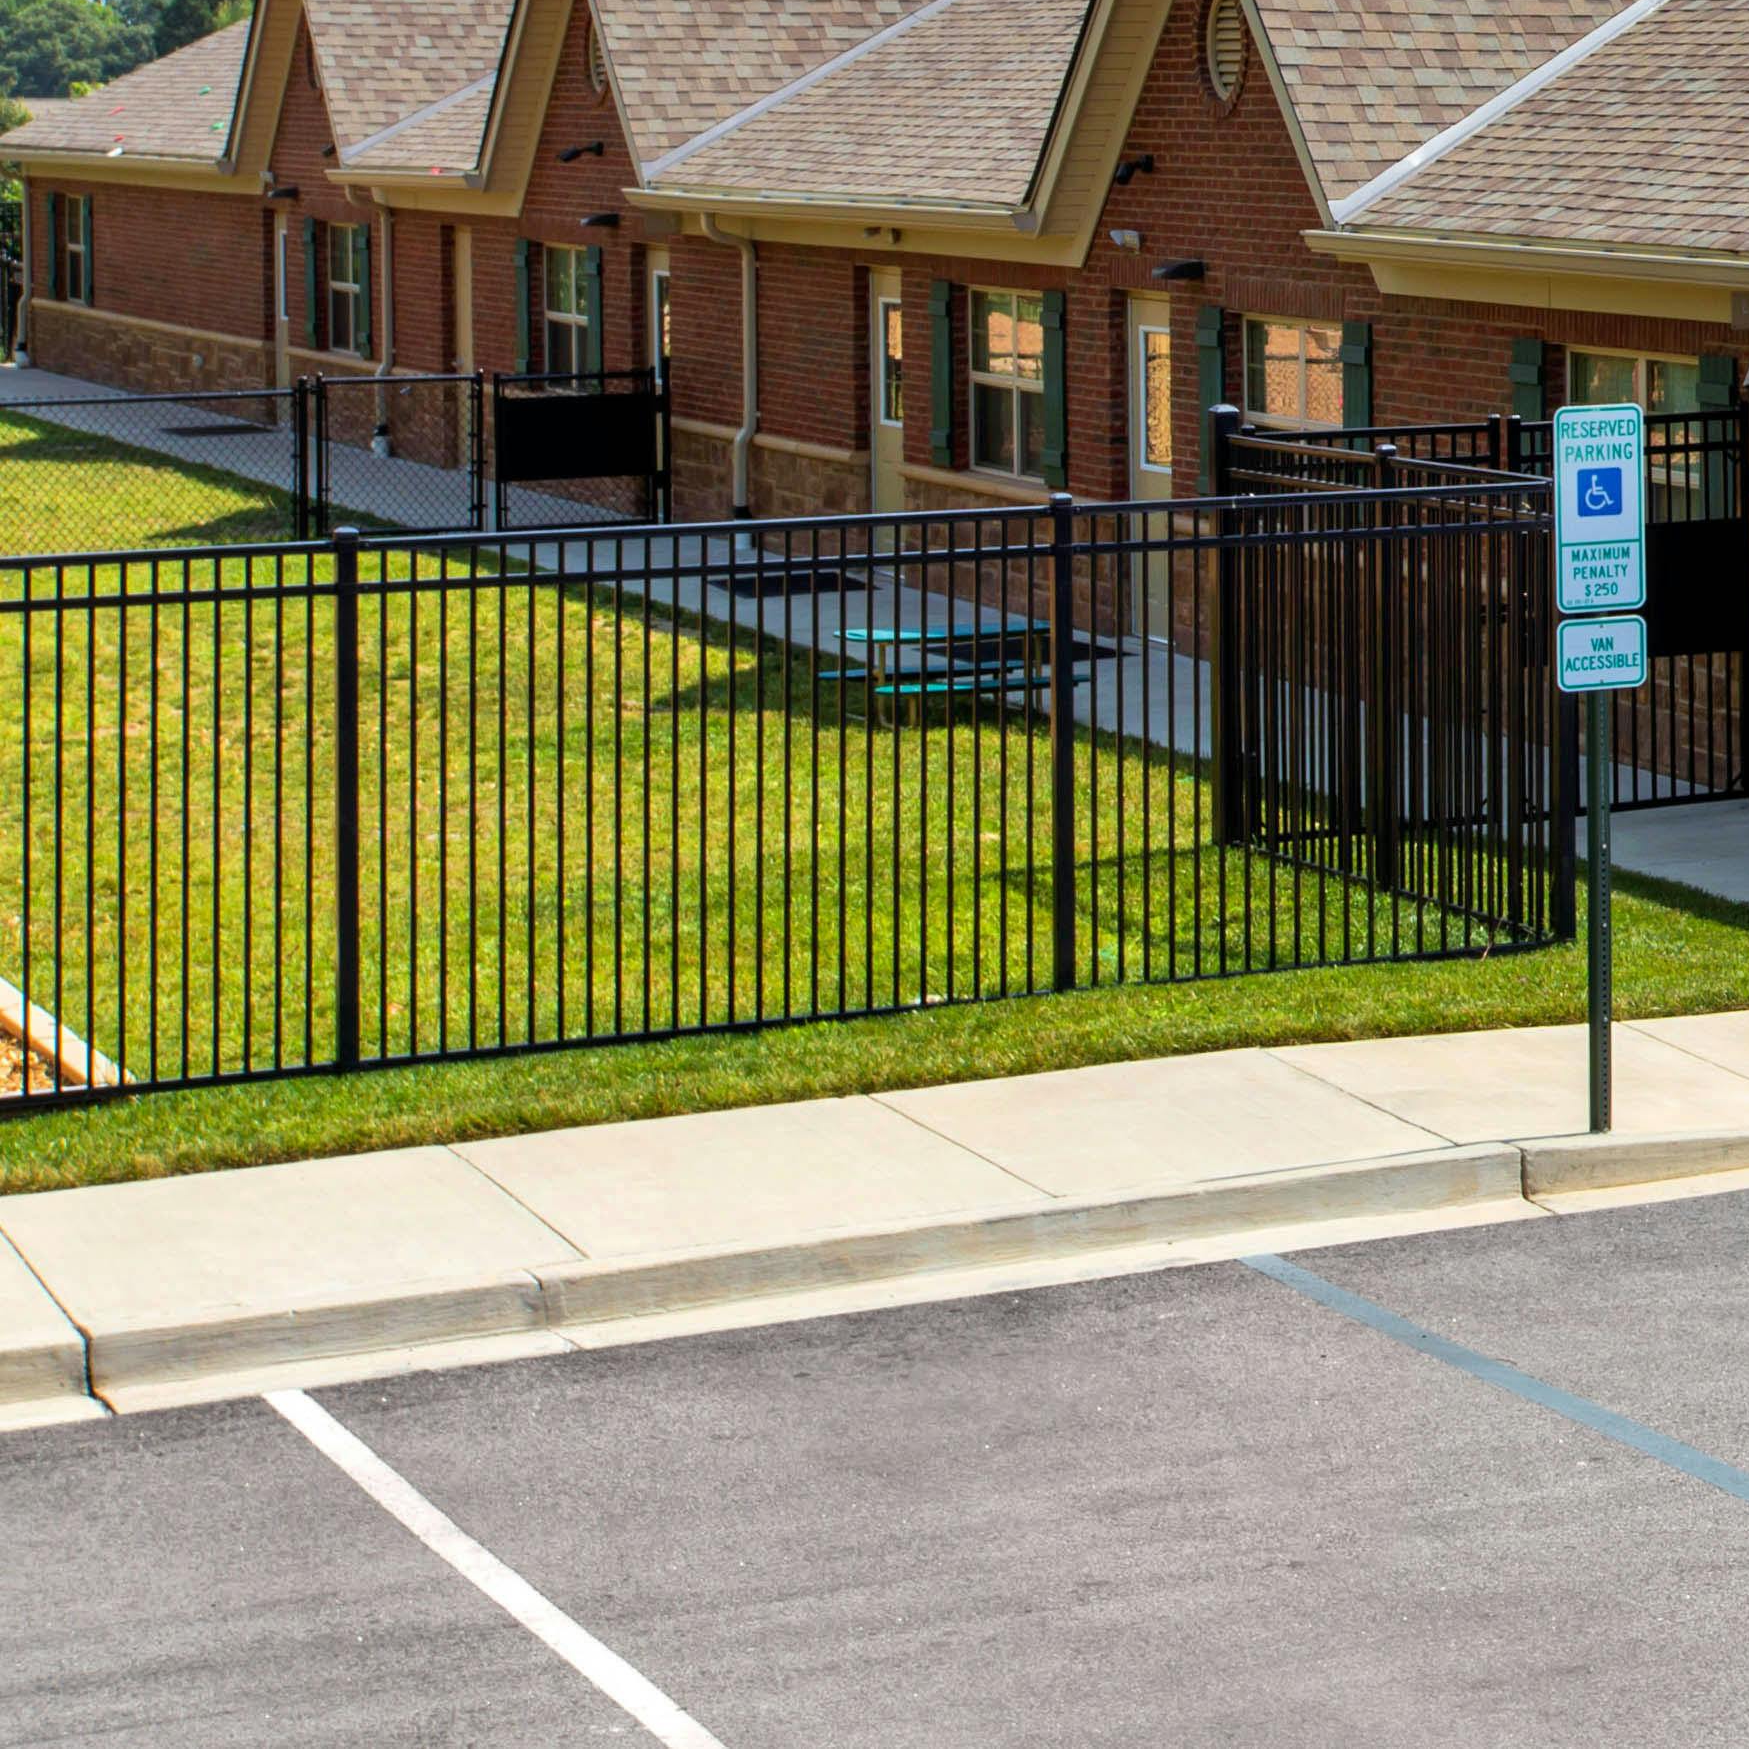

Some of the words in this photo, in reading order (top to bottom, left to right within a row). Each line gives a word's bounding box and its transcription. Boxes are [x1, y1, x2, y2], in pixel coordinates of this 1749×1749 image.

[1561, 419, 1636, 439] RESERVED
[1565, 442, 1633, 463] PARKING
[1571, 546, 1631, 562] MAXIMUM
[1573, 564, 1628, 580] PENALTY
[1590, 636, 1614, 652] VAN
[1565, 653, 1640, 672] ACCESSIBLE
